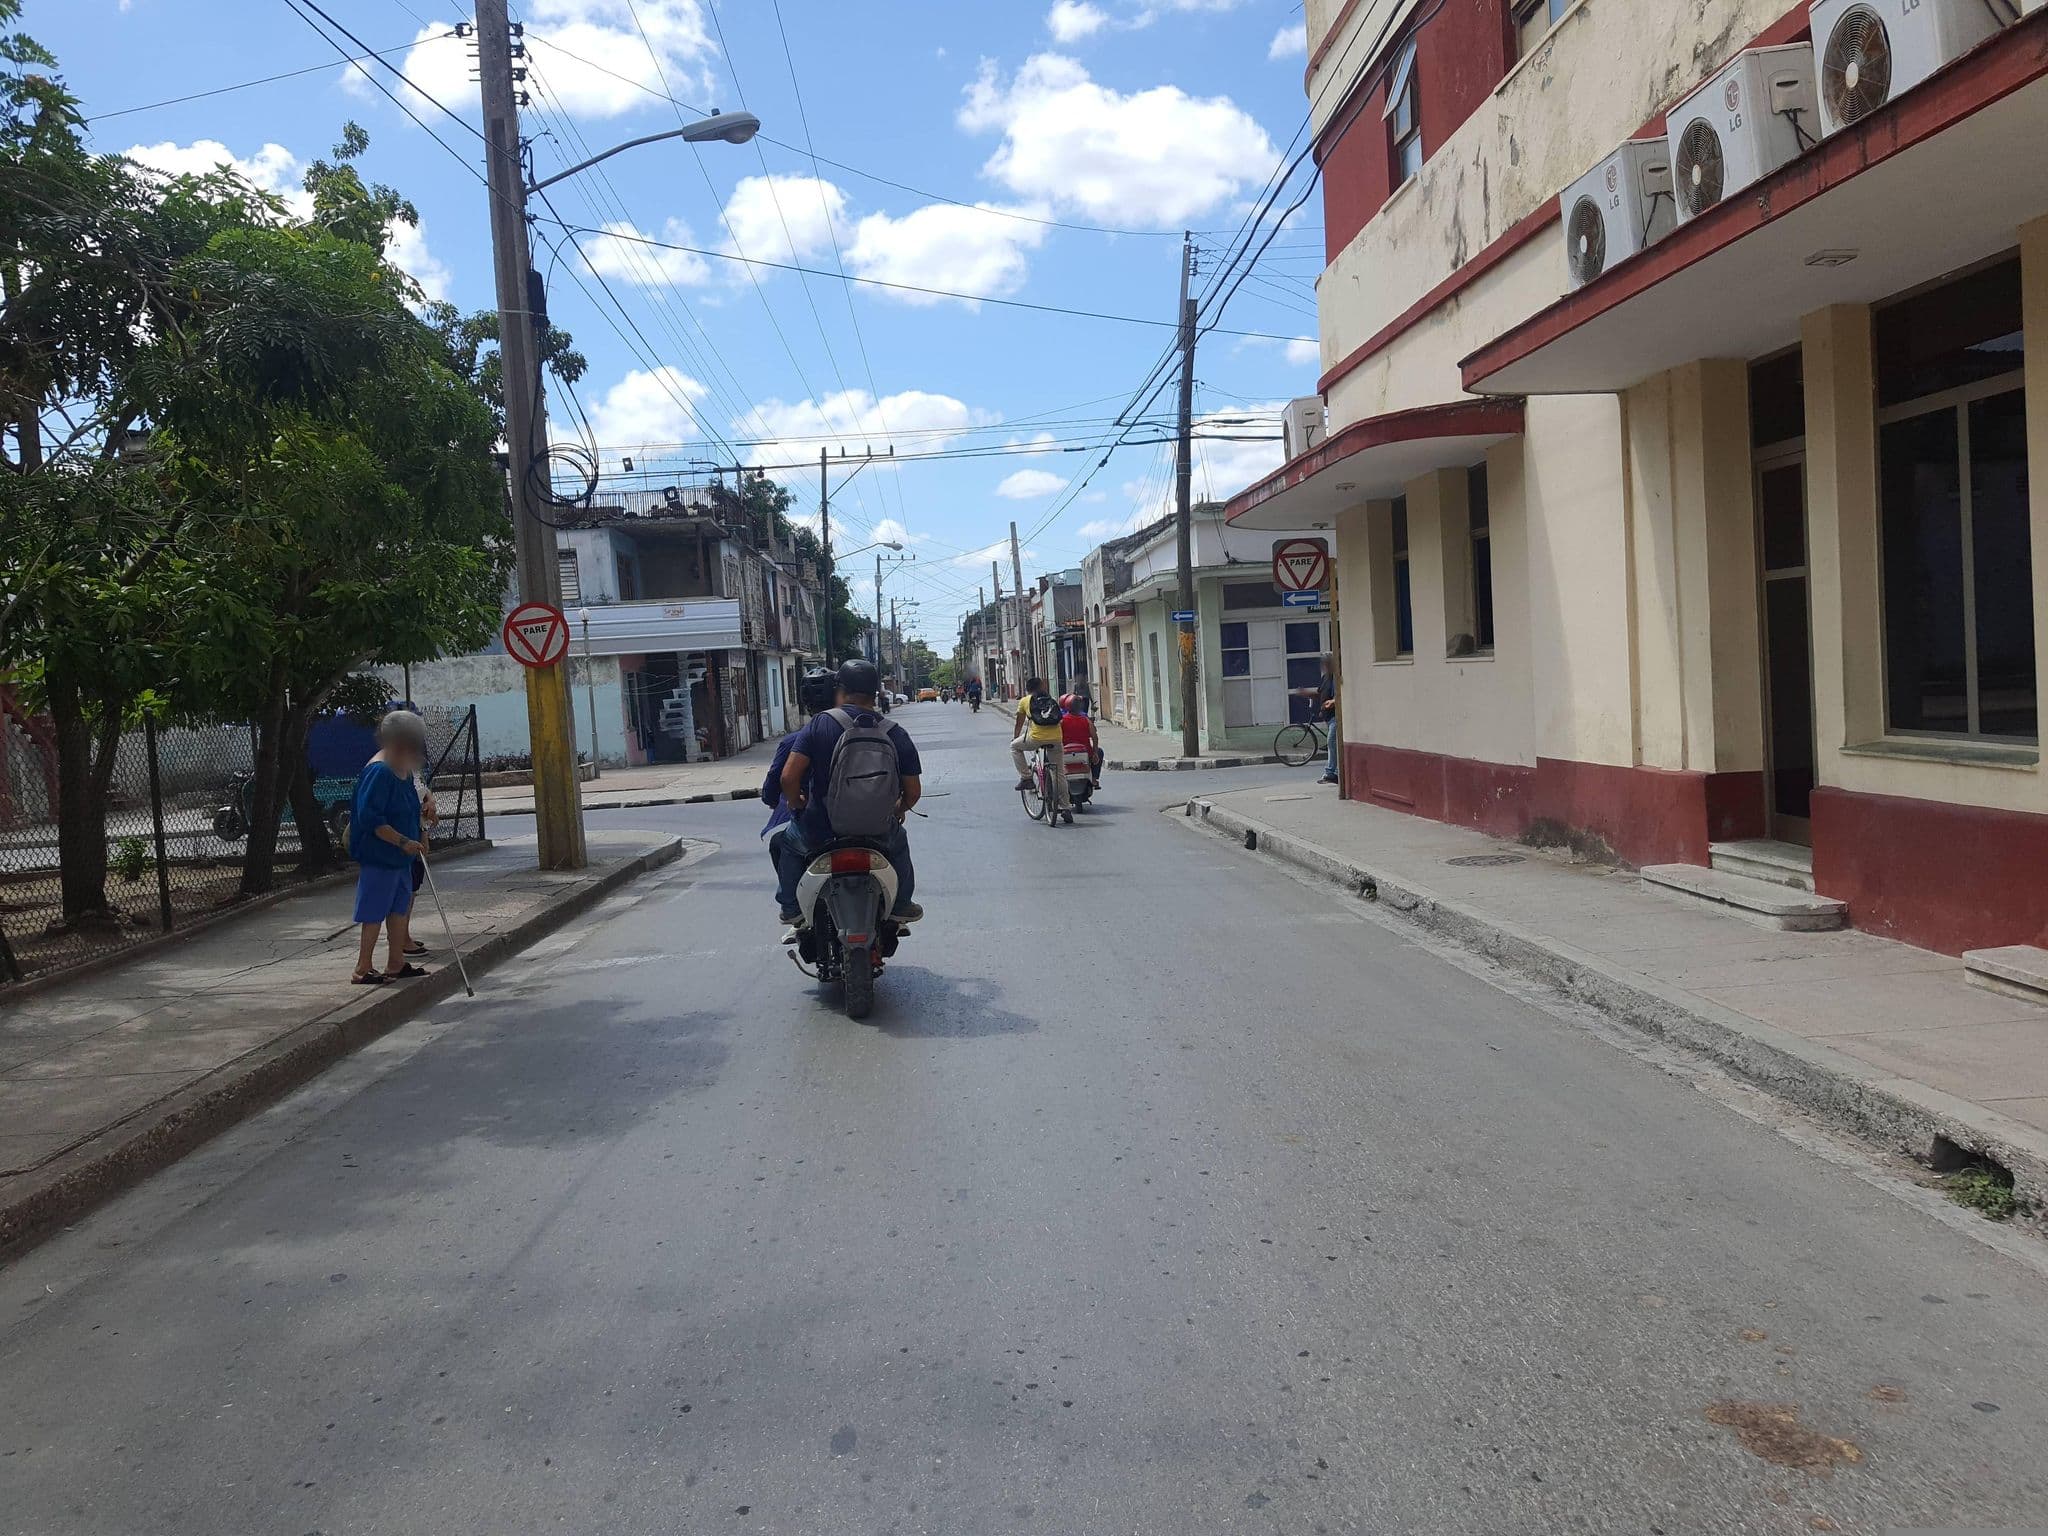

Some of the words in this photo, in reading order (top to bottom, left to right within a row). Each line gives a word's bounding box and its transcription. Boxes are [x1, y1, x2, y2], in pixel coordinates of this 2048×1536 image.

[1729, 113, 1741, 132] LG
[1609, 194, 1619, 210] LG
[1290, 558, 1312, 566] PARE
[523, 624, 547, 635] PARE
